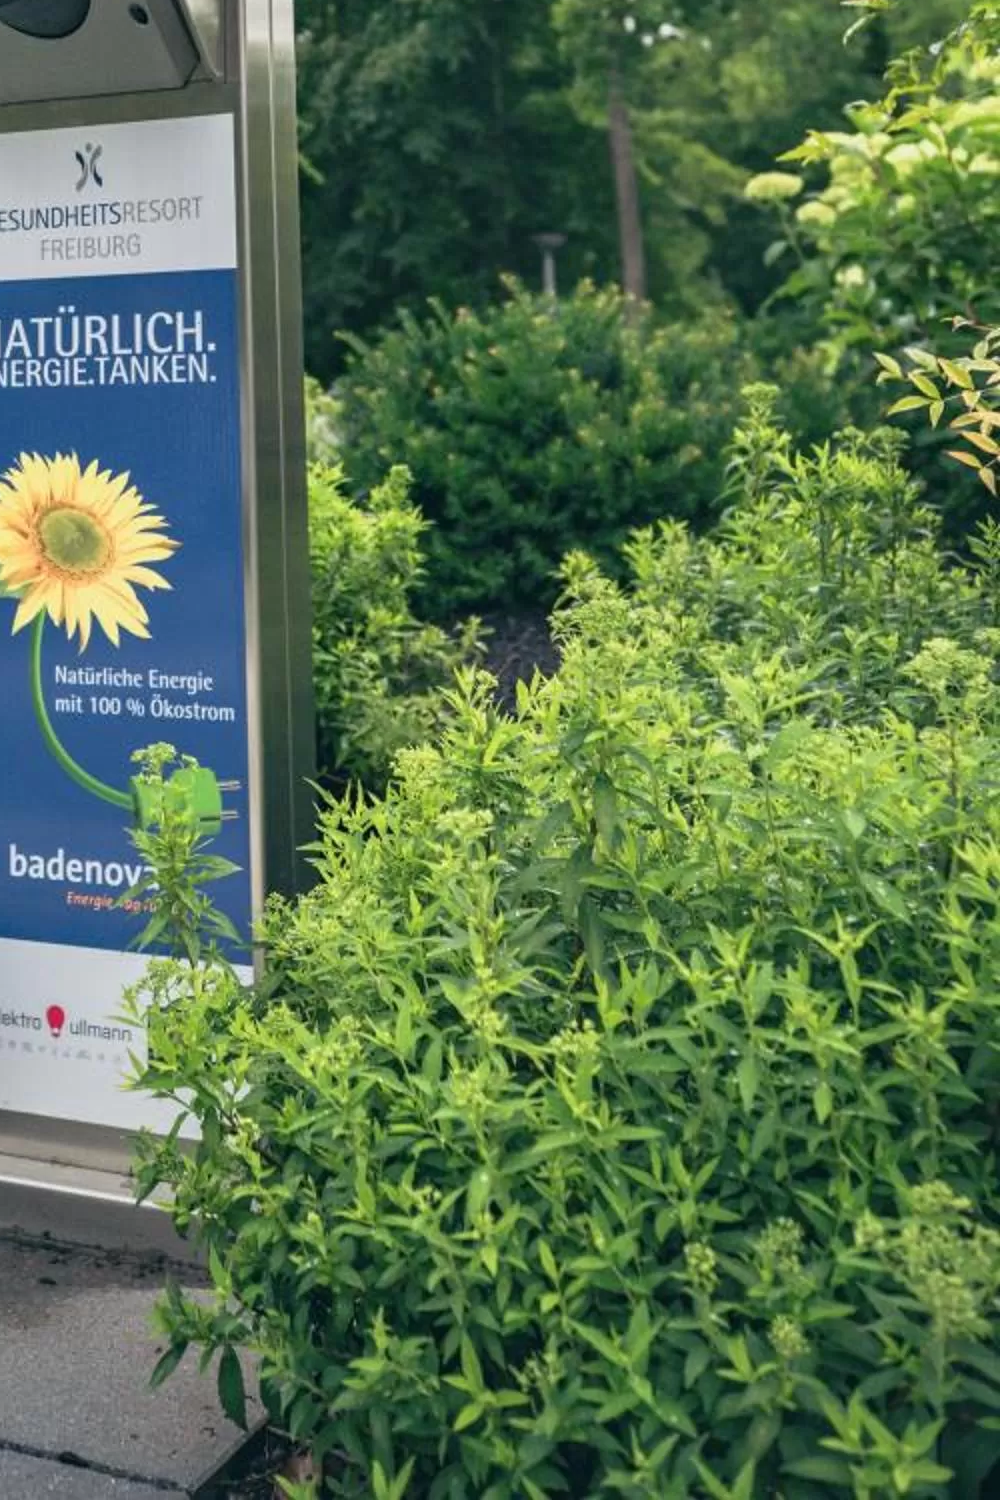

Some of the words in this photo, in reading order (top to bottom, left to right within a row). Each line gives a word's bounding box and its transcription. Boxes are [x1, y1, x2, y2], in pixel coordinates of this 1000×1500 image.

[40, 233, 141, 261] FREIBURG
[55, 665, 143, 688] Natürliche
[149, 669, 213, 695] Energie
[55, 693, 83, 714] mit
[91, 697, 121, 715] 100
[126, 699, 145, 717] %
[151, 694, 235, 722] Ökostrom
[69, 1019, 133, 1041] ullmann
